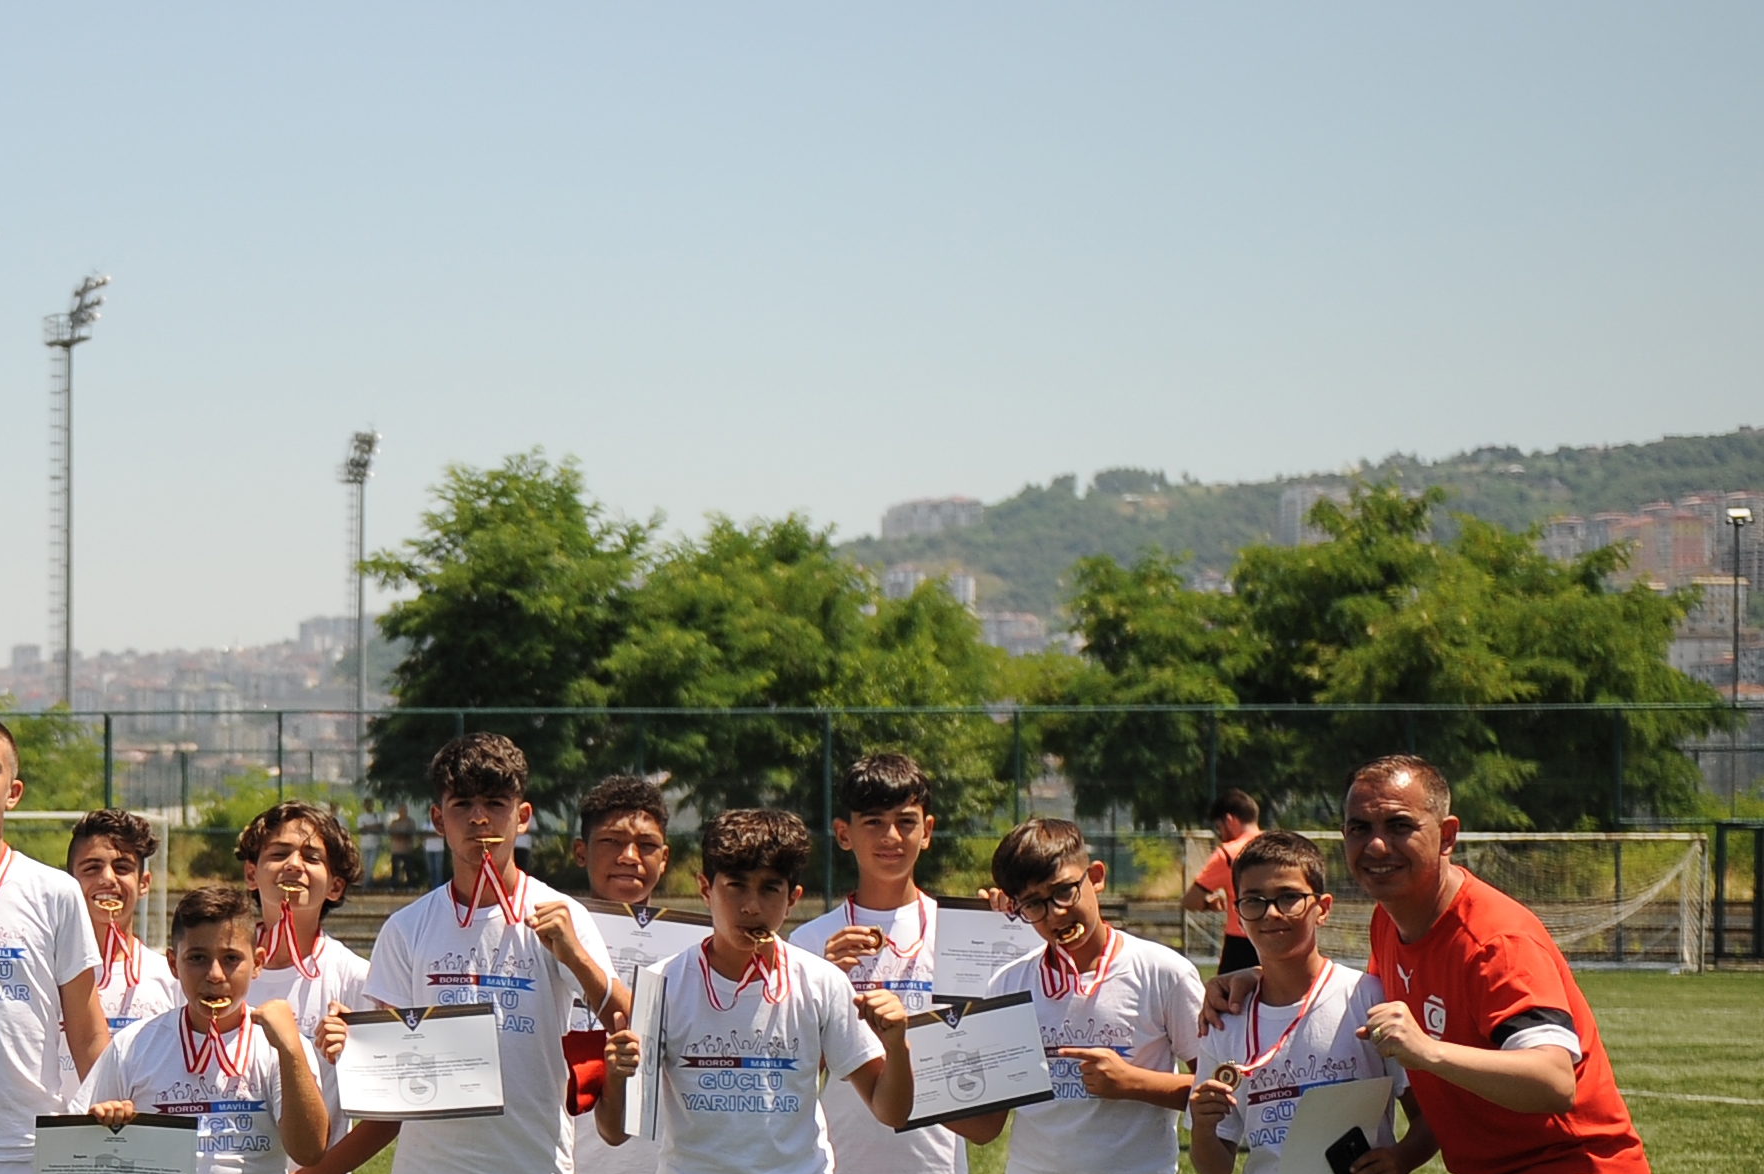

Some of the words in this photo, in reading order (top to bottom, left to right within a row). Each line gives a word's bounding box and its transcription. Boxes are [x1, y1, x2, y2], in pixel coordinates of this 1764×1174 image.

[439, 976, 474, 984] BORDO
[698, 1059, 734, 1067] BORDO
[698, 1070, 783, 1092] GÜÇLÜ
[1259, 1090, 1292, 1101] BORDO
[681, 1093, 799, 1112] YARINLAR
[167, 1104, 204, 1113] BORDO
[197, 1135, 270, 1151] INLAR
